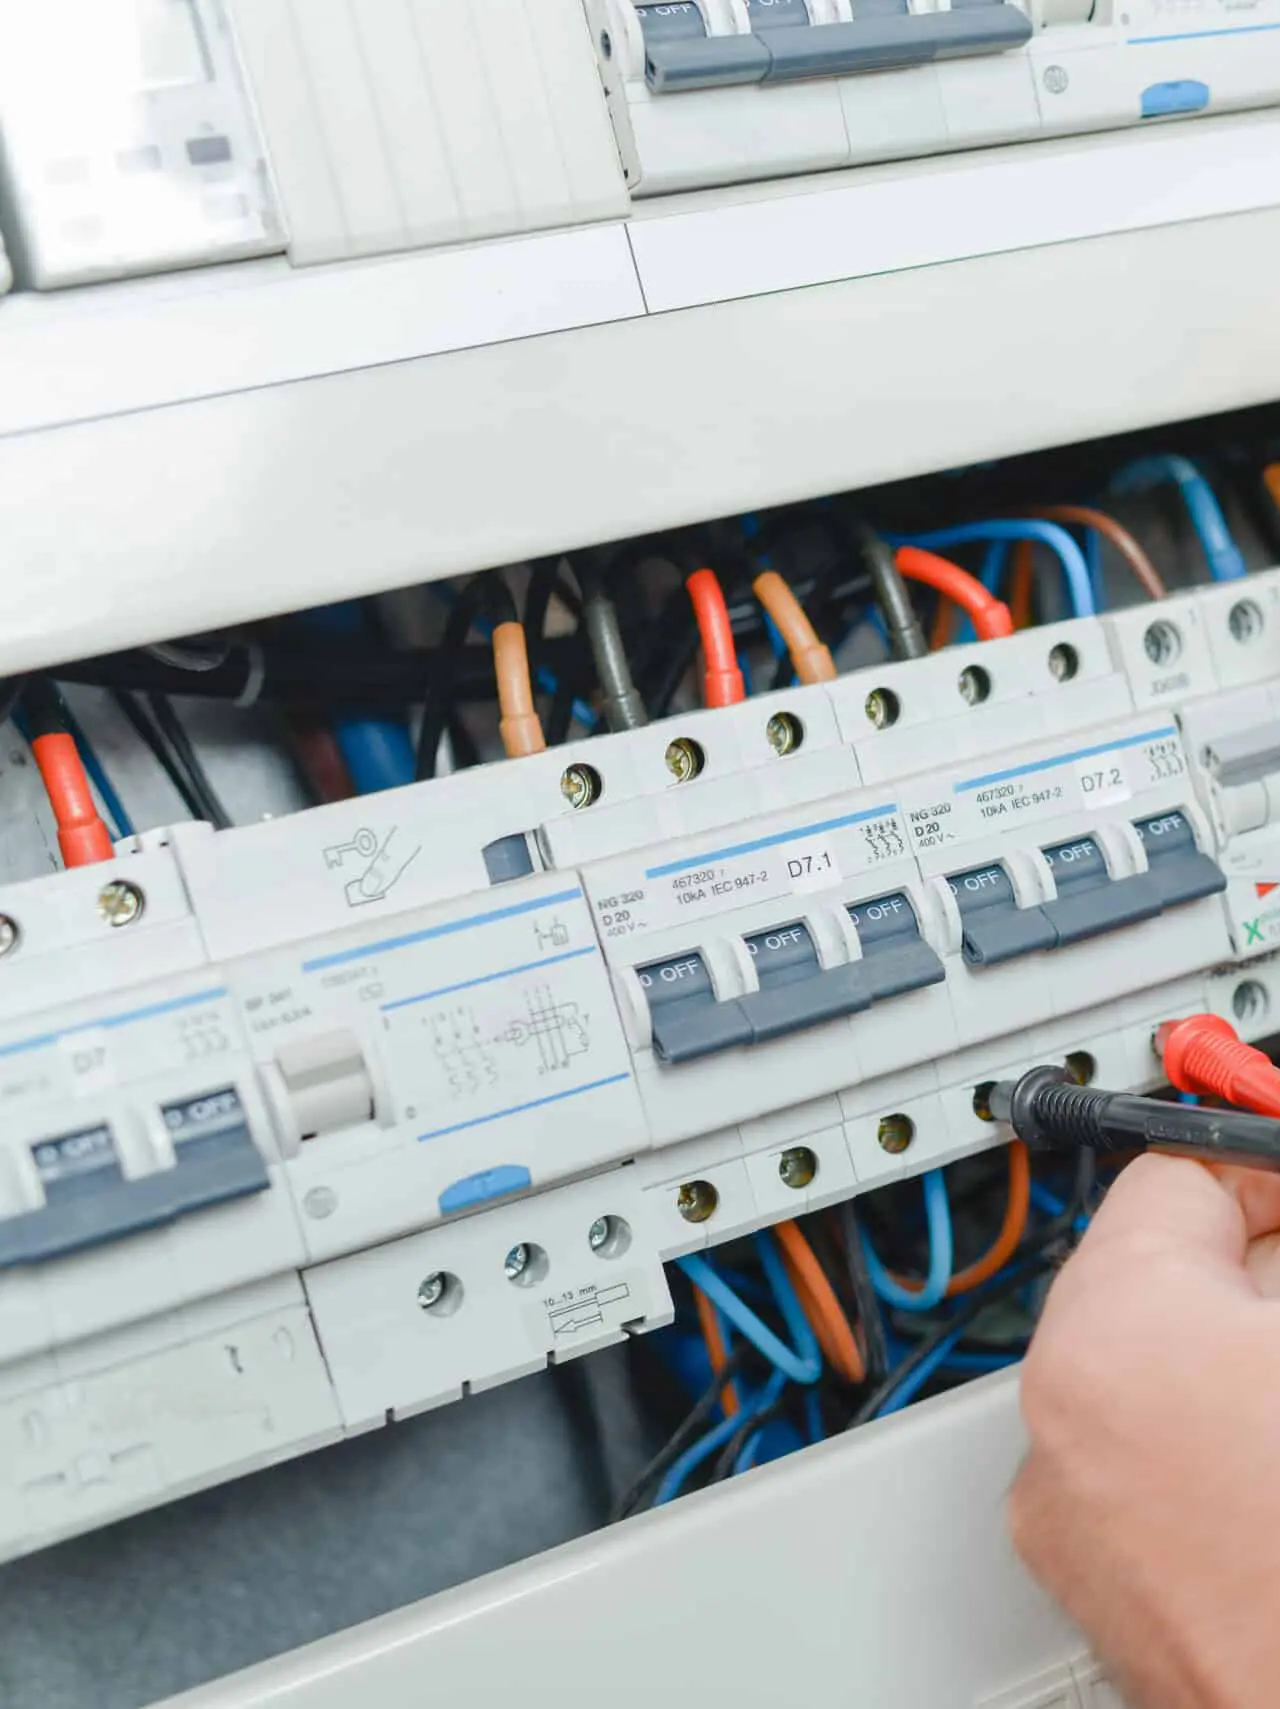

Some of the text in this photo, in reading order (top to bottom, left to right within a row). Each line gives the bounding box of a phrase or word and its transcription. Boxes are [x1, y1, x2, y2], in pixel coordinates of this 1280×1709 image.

[655, 4, 692, 17] OFF
[1081, 768, 1123, 792] D7.2
[976, 785, 1014, 803] 467320
[910, 802, 952, 823] NG 320
[980, 803, 1007, 818] 10kA
[1012, 796, 1031, 809] IEC
[914, 822, 940, 837] D 20
[1149, 814, 1182, 834] OFF
[919, 837, 936, 848] 400
[1060, 842, 1092, 862] OFF
[788, 852, 832, 878] D7.1
[672, 869, 715, 890] 467320
[676, 870, 768, 905] 10kA IEC 947-2
[964, 870, 1000, 891] OFF
[598, 890, 644, 911] NG 320
[866, 899, 902, 920] OFF
[602, 910, 631, 926] D 20
[607, 926, 626, 938] 400
[765, 928, 801, 950] OFF
[660, 959, 699, 982] OFF
[579, 1284, 597, 1296] mm
